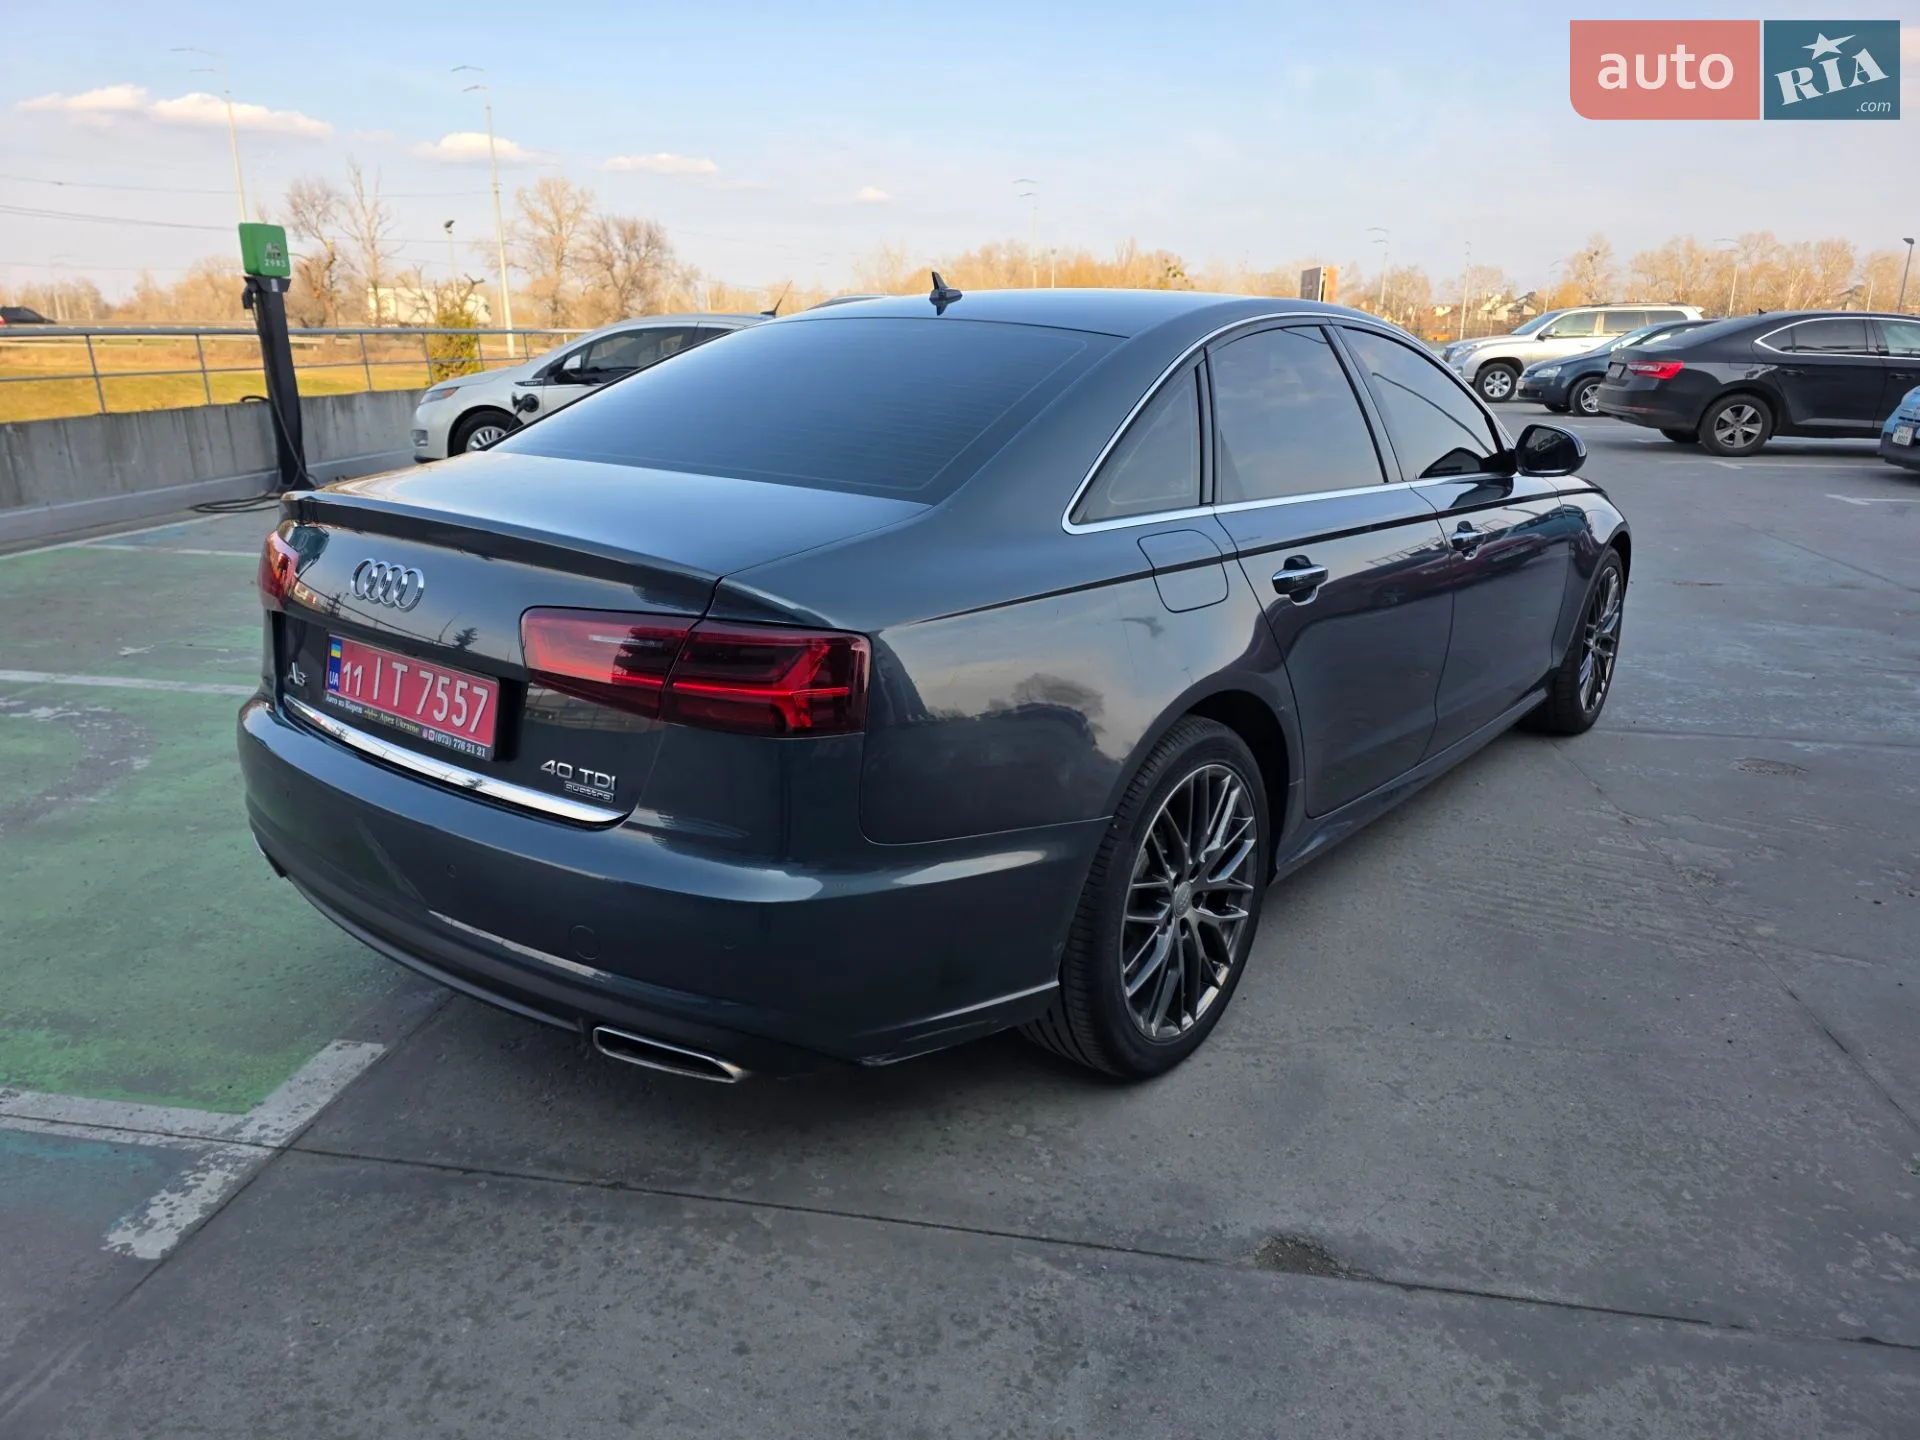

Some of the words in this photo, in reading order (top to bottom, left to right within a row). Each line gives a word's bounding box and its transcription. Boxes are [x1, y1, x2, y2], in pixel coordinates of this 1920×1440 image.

[288, 662, 306, 687] A6
[329, 671, 339, 687] UA
[343, 661, 363, 697] 11
[373, 656, 409, 707] IT
[416, 670, 489, 733] 7557
[395, 716, 420, 733] Ukraine
[540, 759, 573, 779] 40
[578, 768, 616, 790] TDI
[564, 783, 612, 801] quattro
